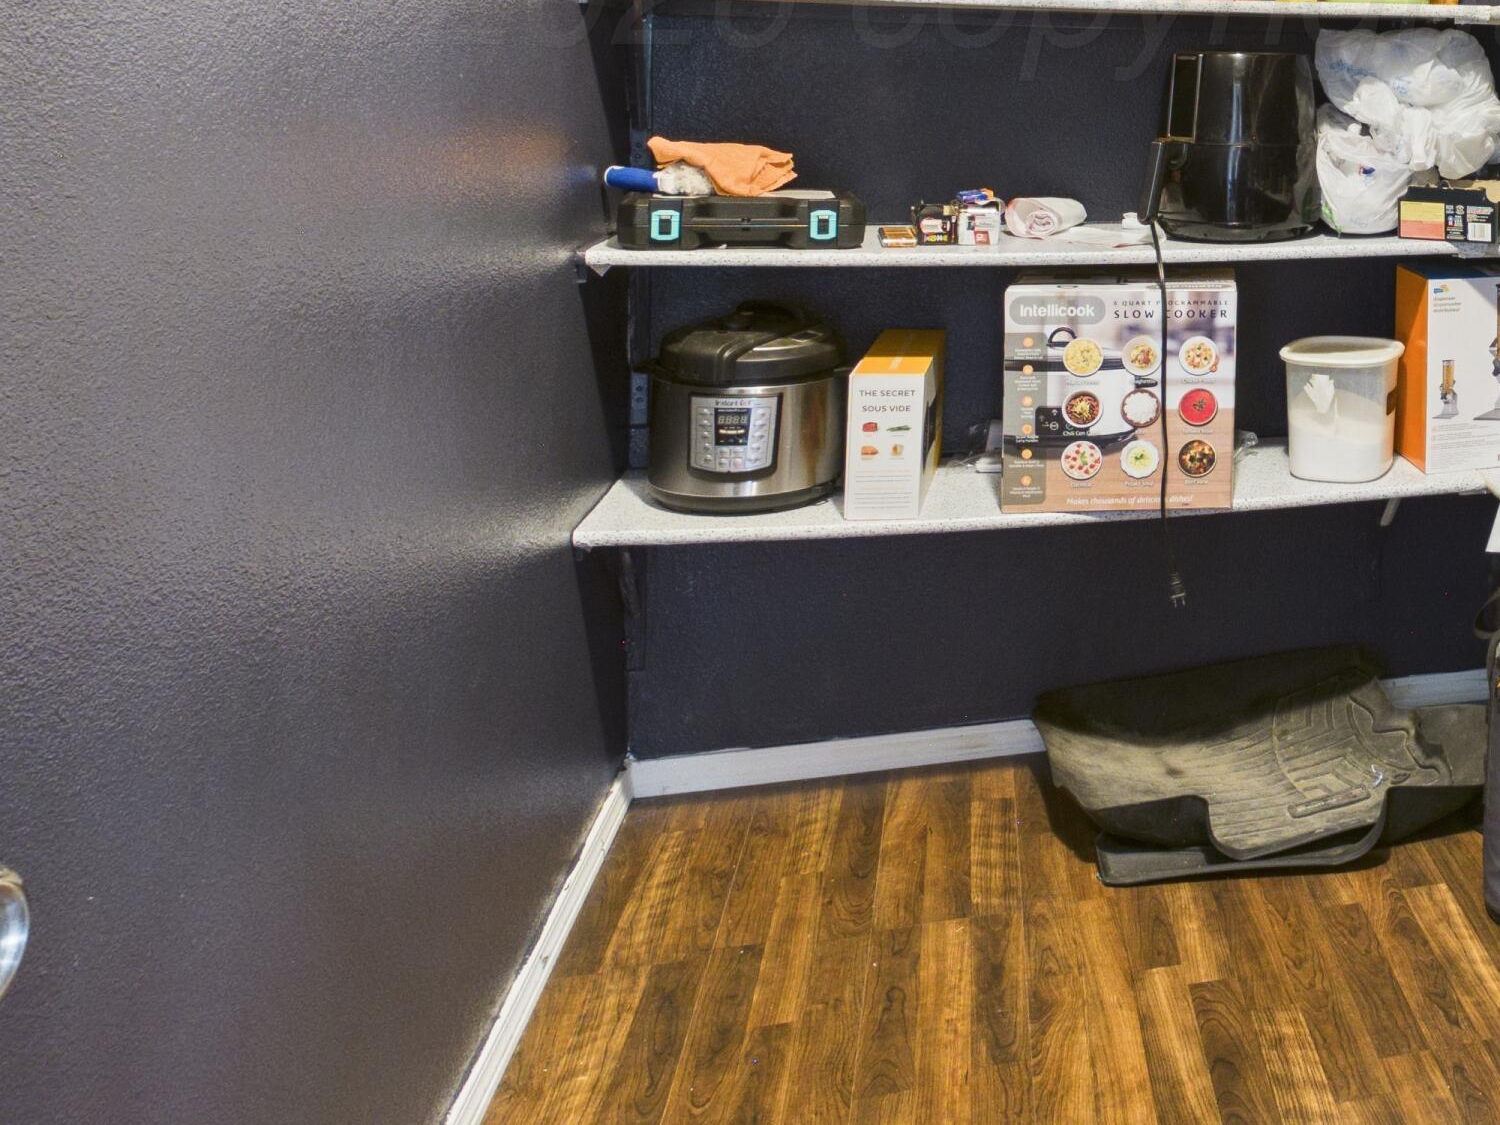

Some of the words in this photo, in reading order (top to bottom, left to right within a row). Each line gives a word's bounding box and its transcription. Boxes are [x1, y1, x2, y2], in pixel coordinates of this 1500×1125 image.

[1020, 304, 1095, 318] Intellicook
[1114, 309, 1155, 319] SLOW
[860, 388, 876, 397] THE
[879, 388, 916, 397] SECRET
